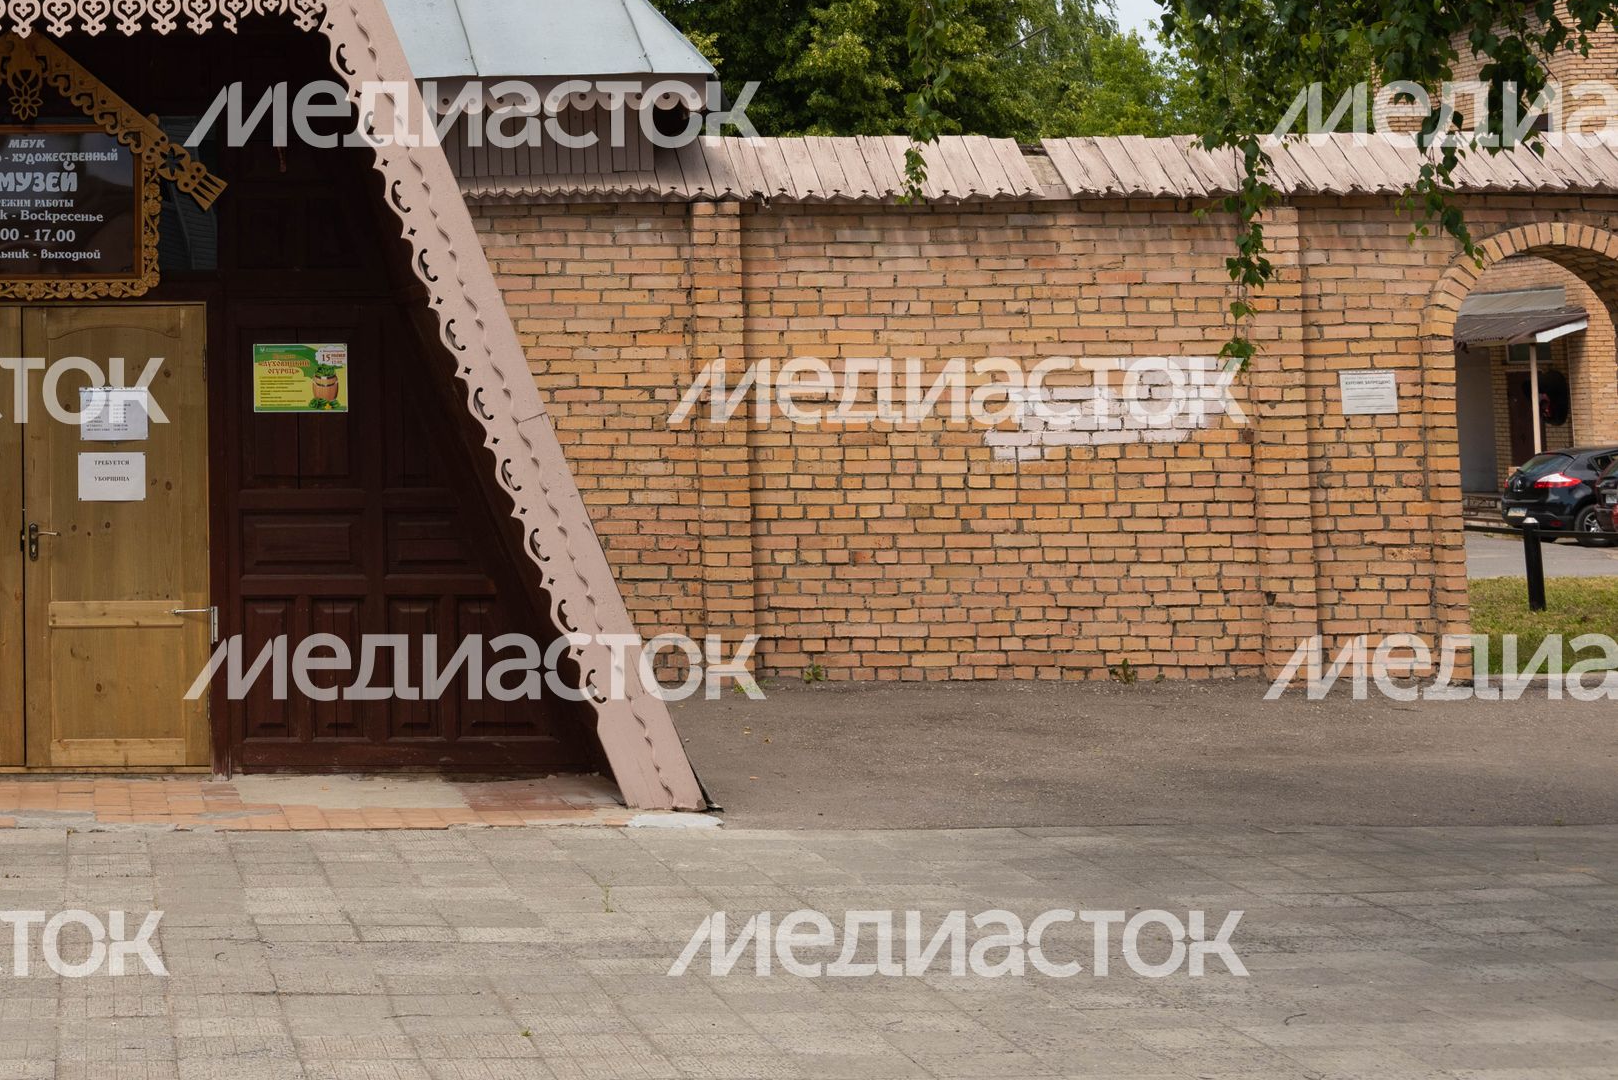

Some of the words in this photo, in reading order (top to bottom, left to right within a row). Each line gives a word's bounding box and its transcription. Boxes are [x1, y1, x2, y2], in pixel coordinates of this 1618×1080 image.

[8, 139, 45, 149] МБУК
[11, 148, 118, 165] ХУДОЖЕСТВЕННЫЙ
[34, 199, 74, 208] РАБОТЫ
[20, 210, 104, 223] Воскресенье
[34, 229, 76, 242] 17.00
